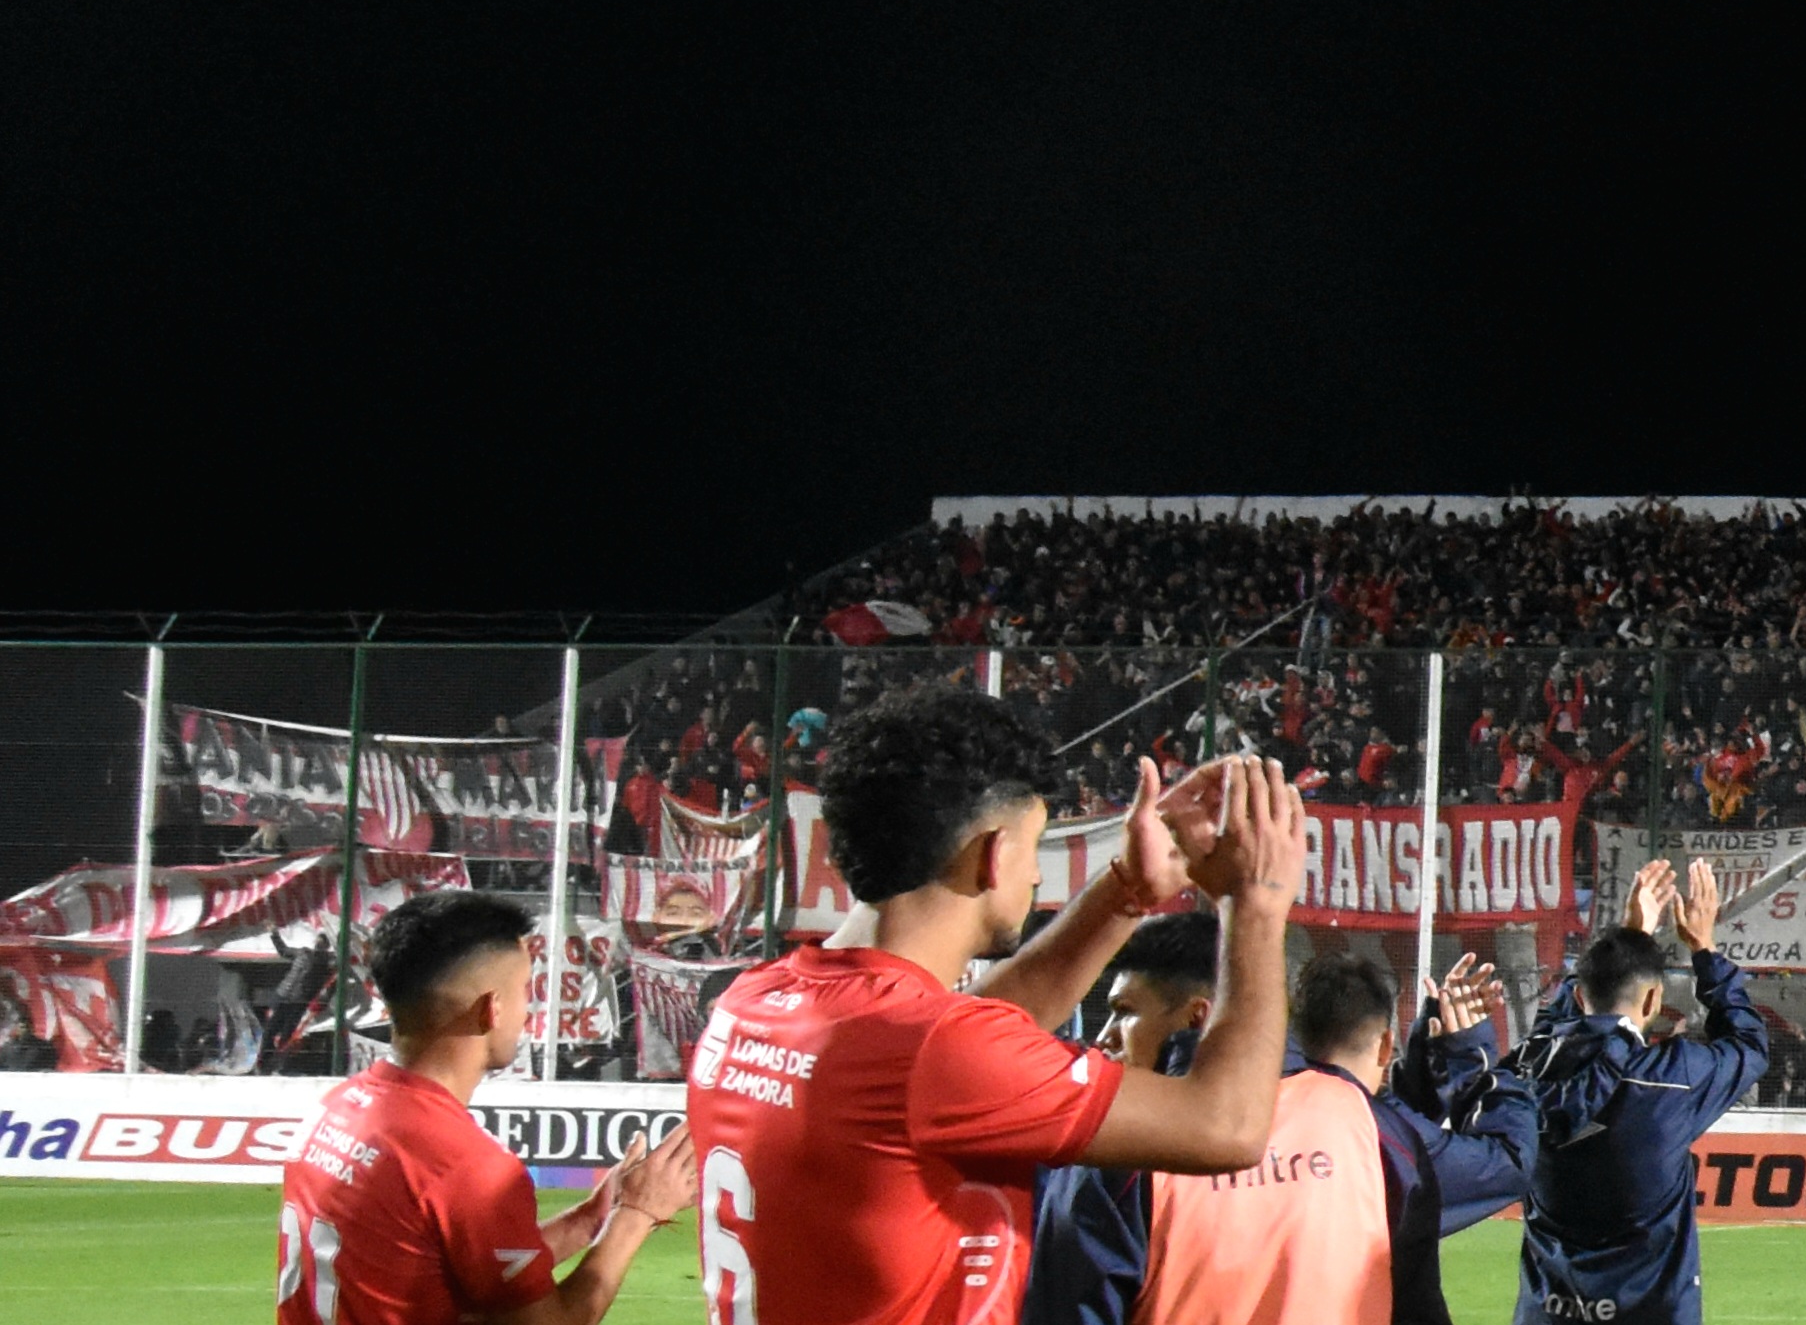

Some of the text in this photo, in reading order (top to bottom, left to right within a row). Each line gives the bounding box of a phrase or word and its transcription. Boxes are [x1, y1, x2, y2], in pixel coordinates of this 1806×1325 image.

[1637, 830, 1685, 849] LOS
[1690, 827, 1779, 851] ANDES
[731, 1033, 818, 1080] LOMAS DE
[720, 1066, 795, 1109] ZAMORA
[304, 1144, 355, 1186] ZAMORA
[354, 1140, 380, 1168] DE
